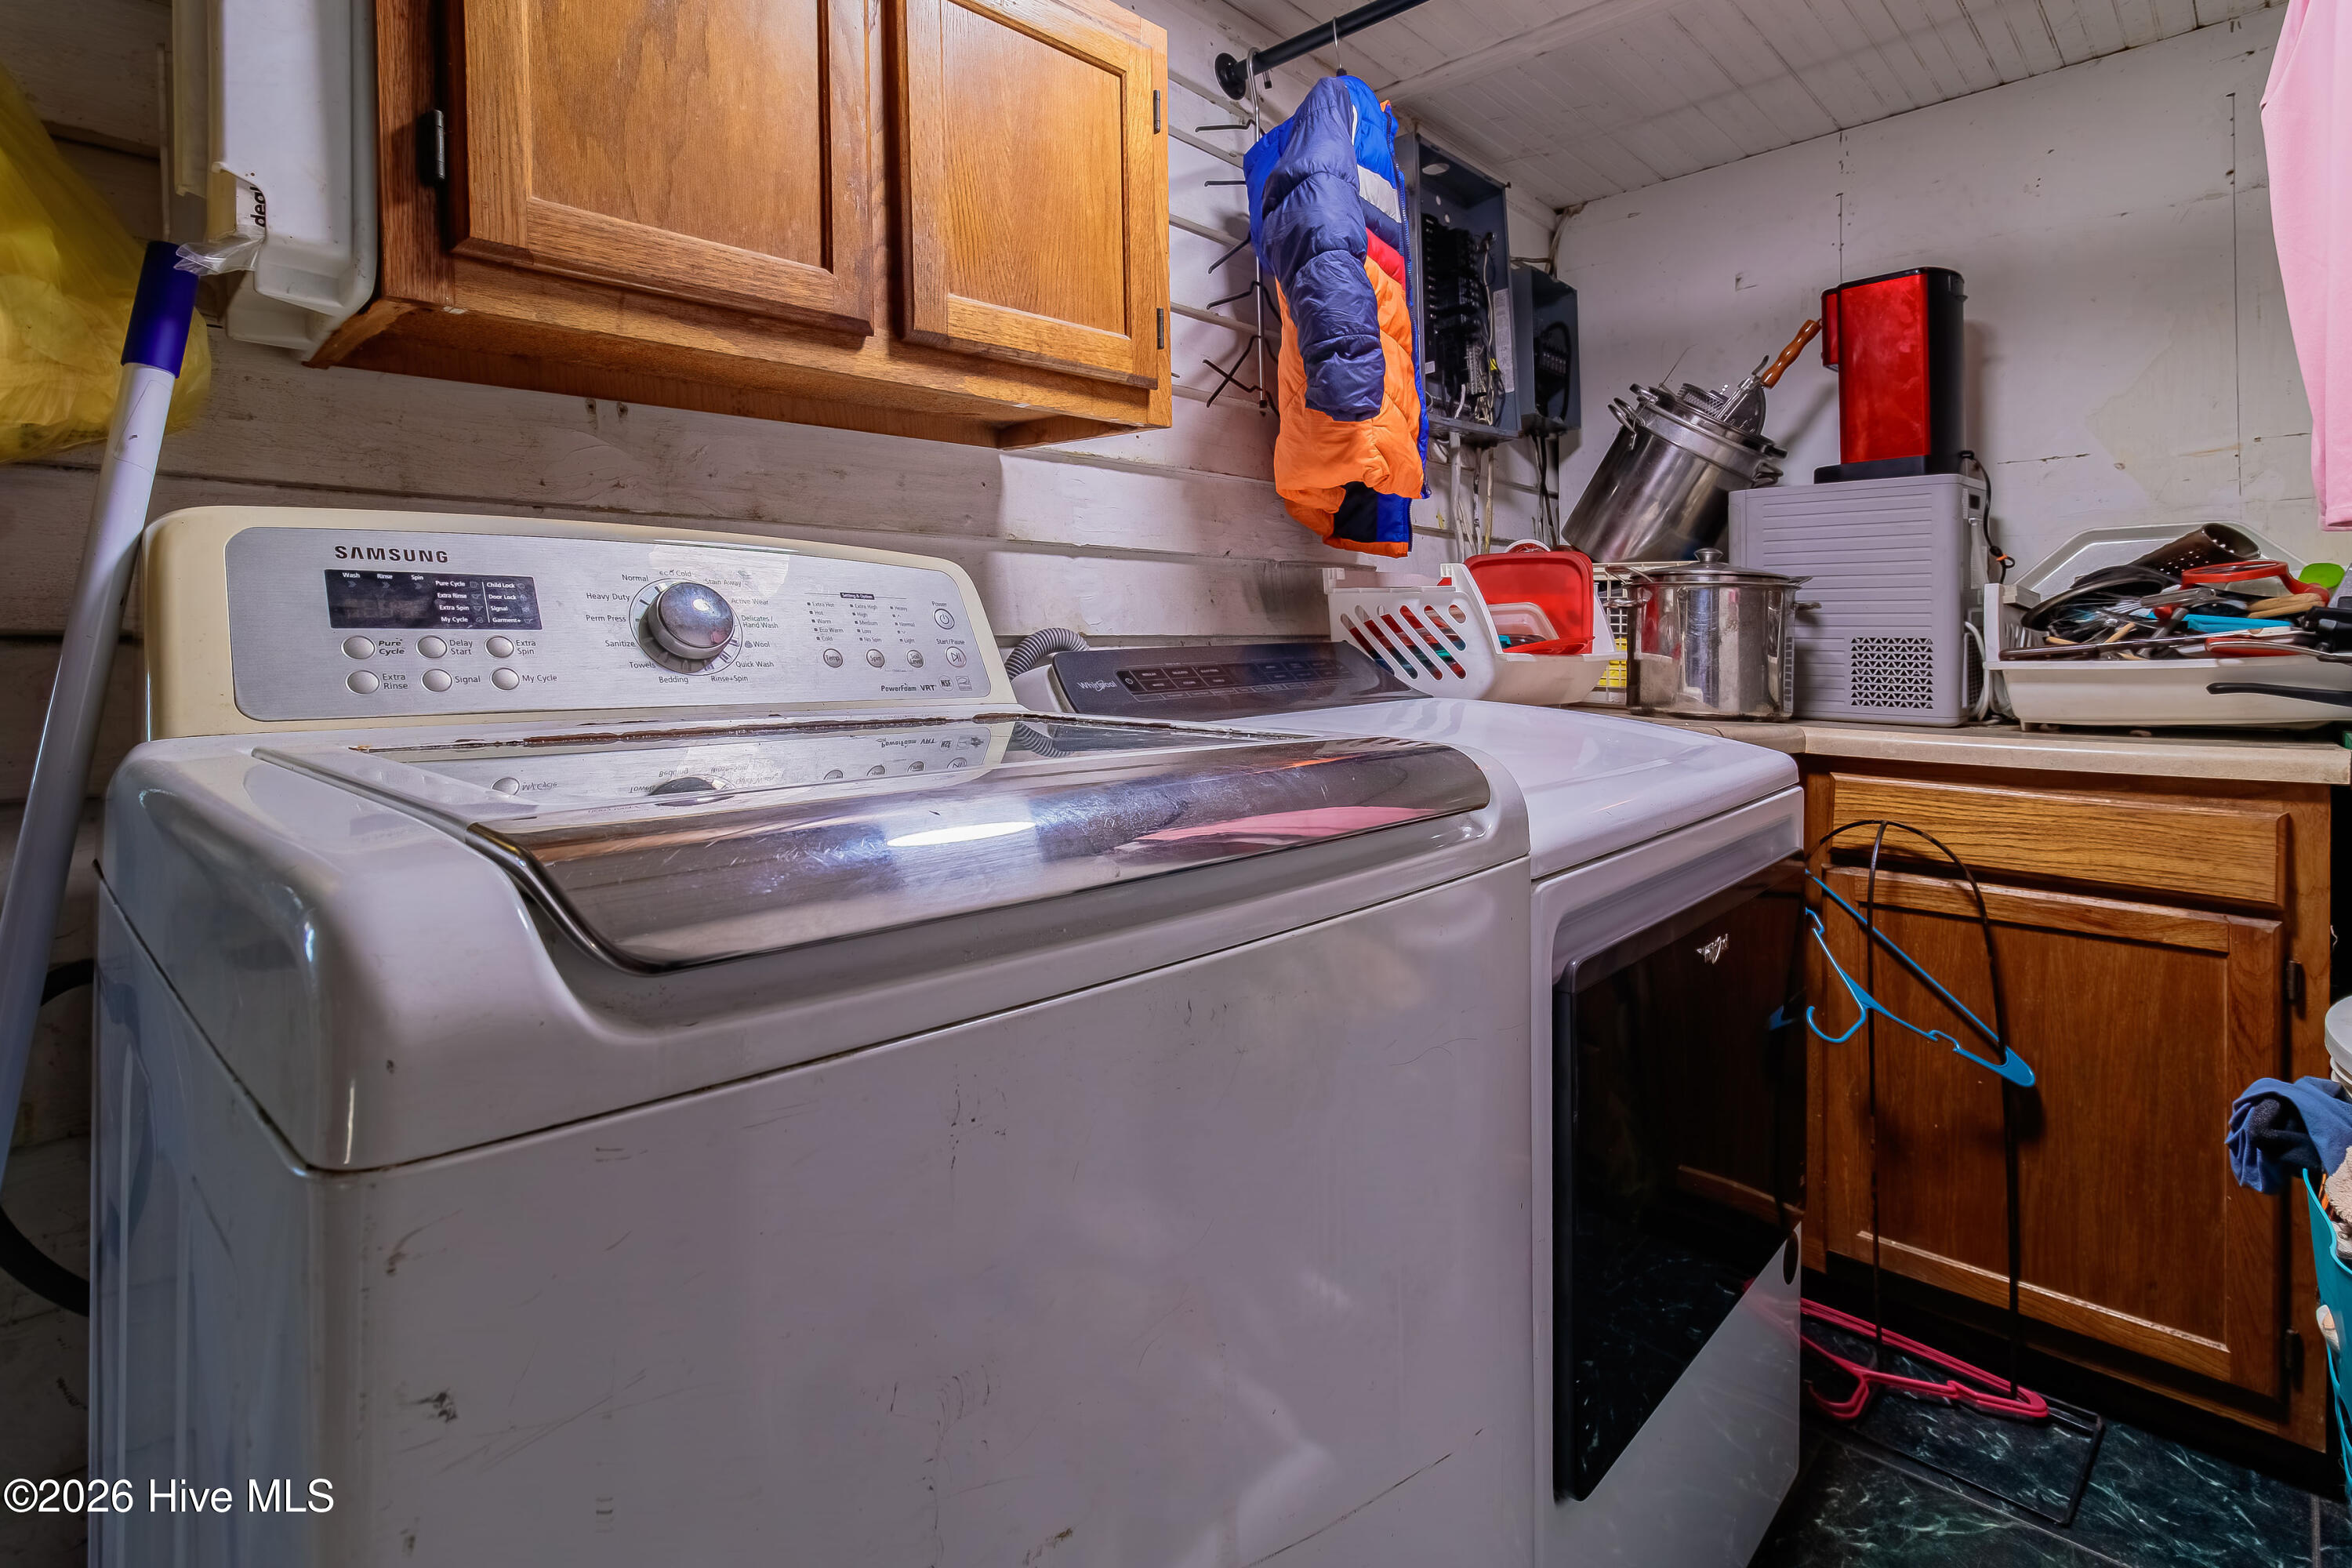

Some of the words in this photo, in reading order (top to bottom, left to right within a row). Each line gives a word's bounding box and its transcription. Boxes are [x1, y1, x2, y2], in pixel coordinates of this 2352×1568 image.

[334, 545, 448, 564] SAMSUNG
[622, 574, 649, 583] Normal
[724, 579, 742, 588] Away
[586, 592, 609, 601] Heavy
[612, 593, 630, 602] Duty
[449, 639, 473, 648] Delay
[379, 647, 405, 655] Cycle
[451, 647, 472, 655] Start
[517, 648, 535, 656] Spin
[735, 660, 754, 669] Quick
[383, 673, 406, 681] Extra
[455, 674, 481, 684] Signal
[522, 674, 535, 683] My
[536, 673, 557, 683] Cycle
[659, 676, 689, 684] Bedding
[383, 681, 408, 690] Rinse
[1077, 680, 1117, 691] Whirlpool
